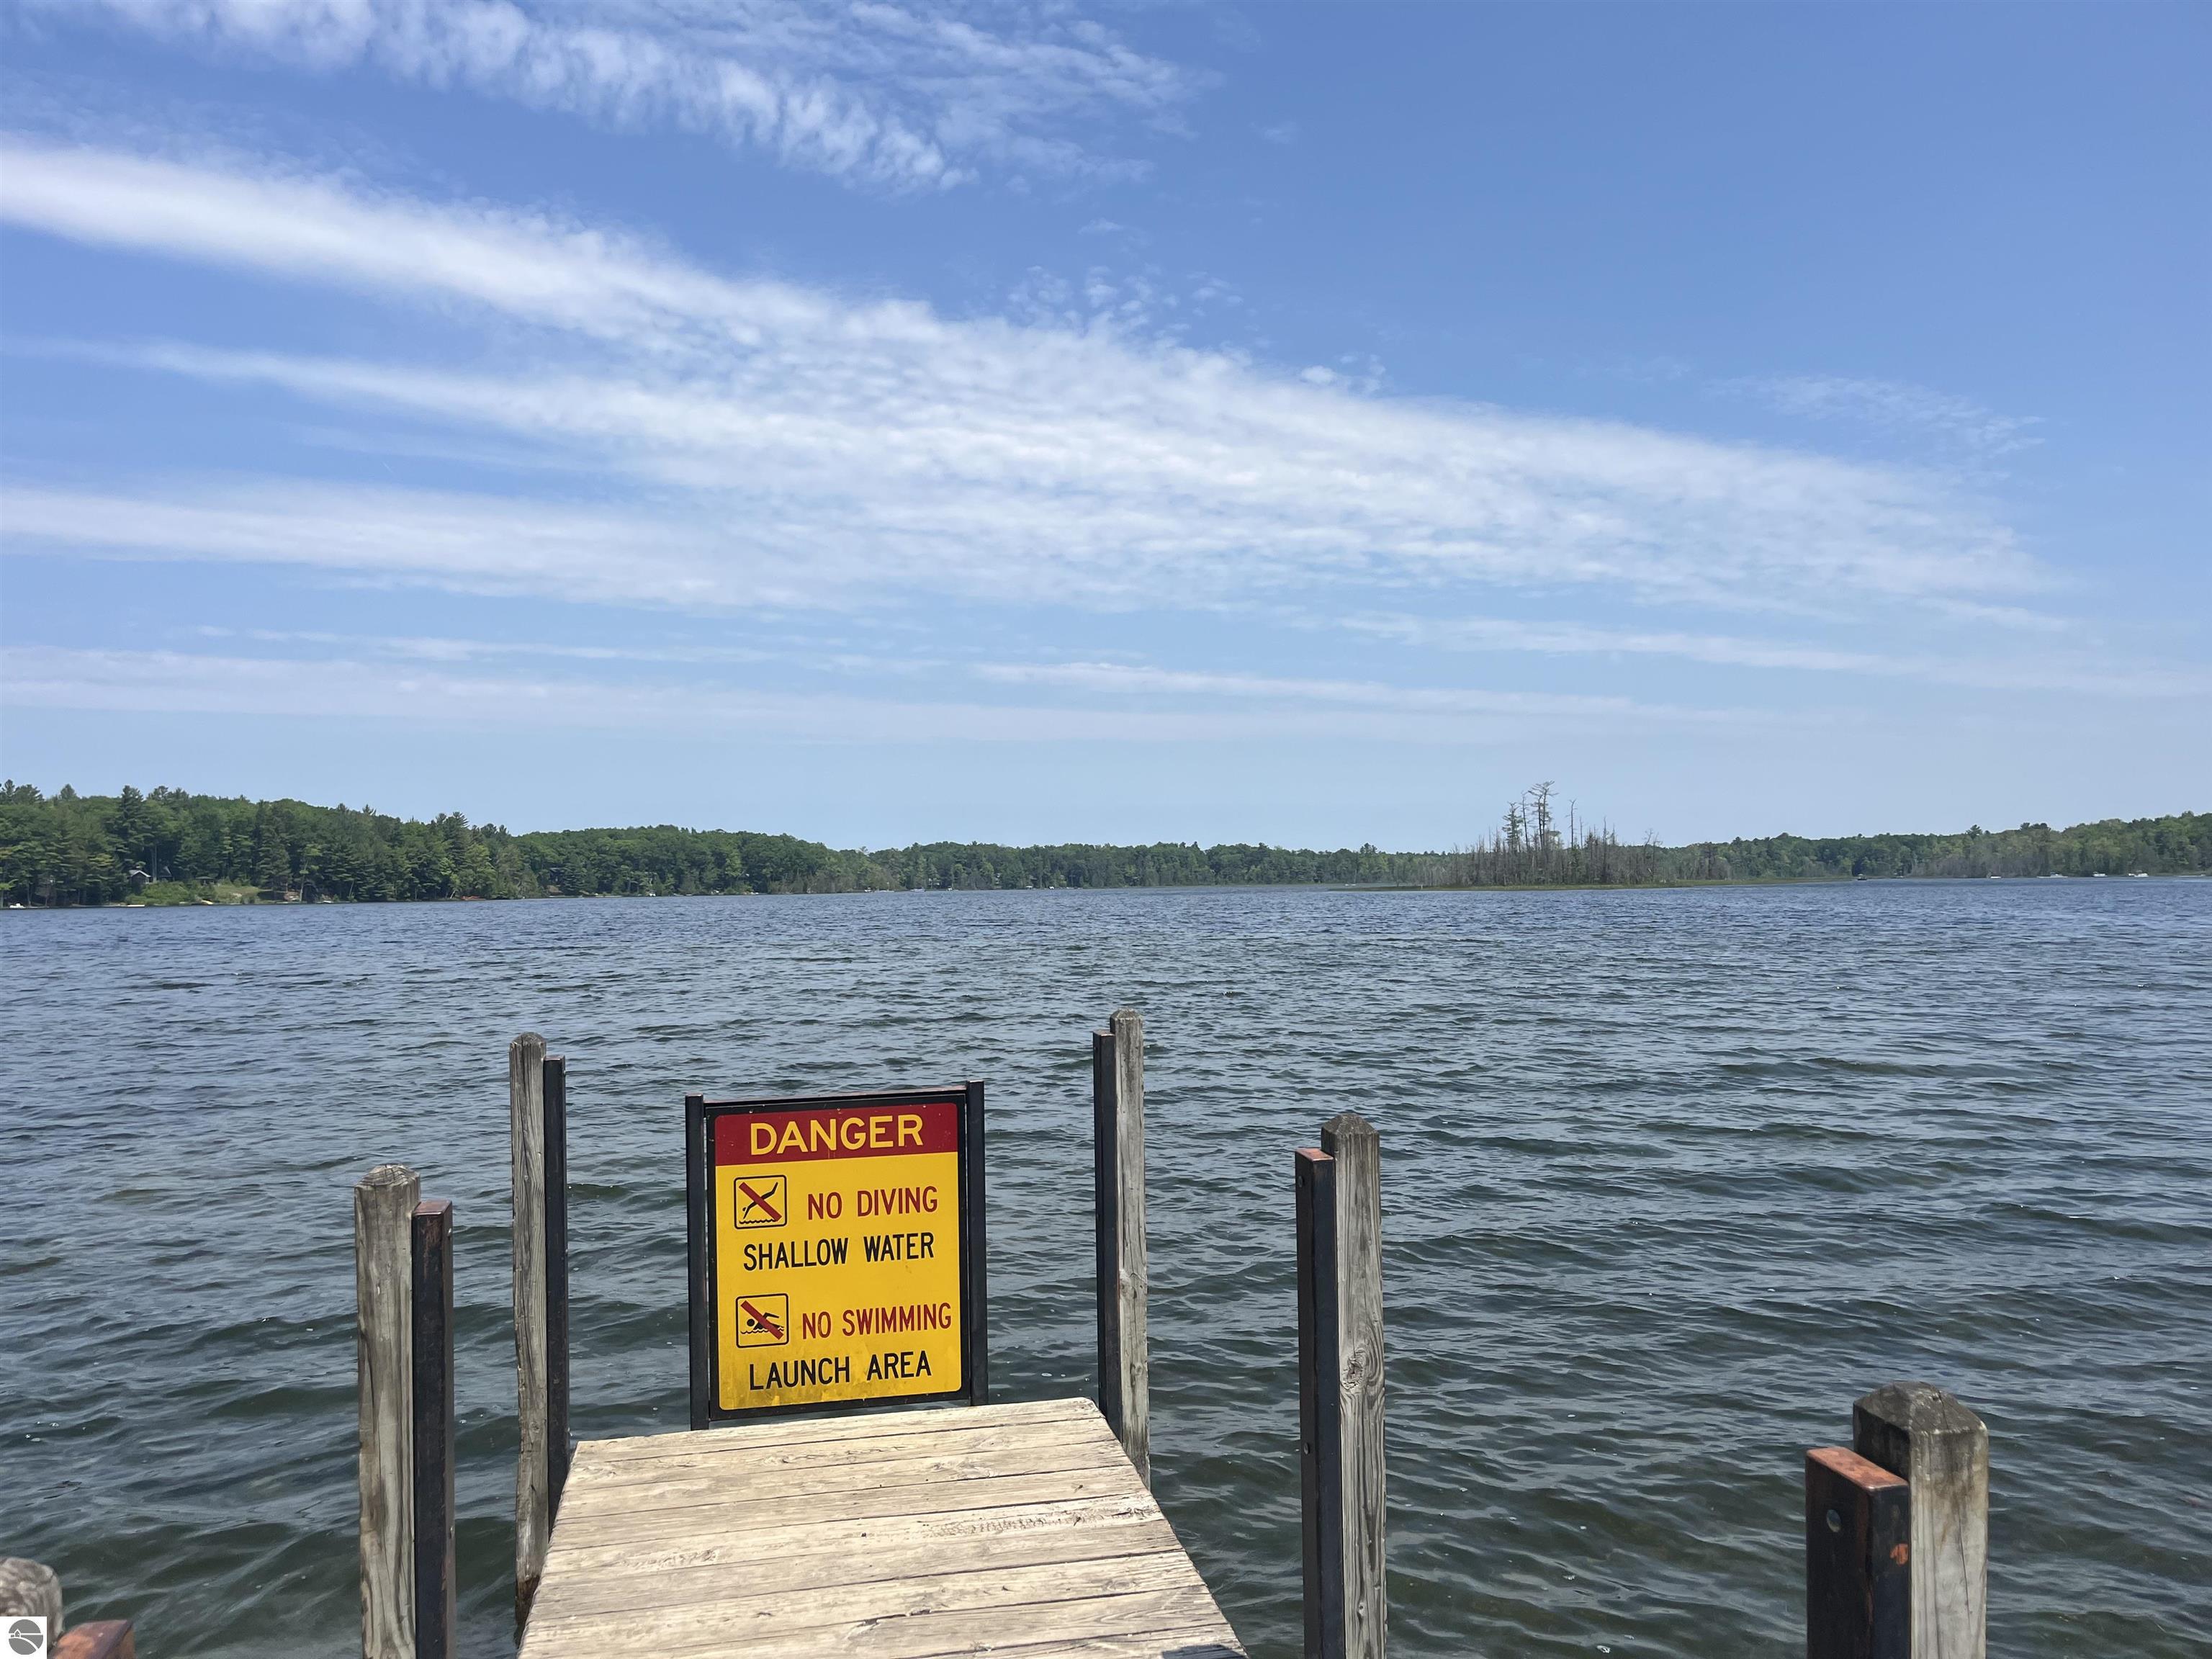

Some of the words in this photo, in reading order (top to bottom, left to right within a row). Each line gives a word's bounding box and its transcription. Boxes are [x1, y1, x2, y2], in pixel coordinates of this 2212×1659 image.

[750, 1114, 923, 1156] DANGER
[807, 1192, 842, 1220] NO
[857, 1185, 938, 1217] DIVING
[743, 1237, 848, 1271] SHALLOW
[863, 1232, 934, 1263] WATER
[802, 1311, 831, 1340] NO
[842, 1303, 951, 1336] SWIMMING
[749, 1356, 850, 1390] LAUNCH
[866, 1350, 931, 1381] AREA
